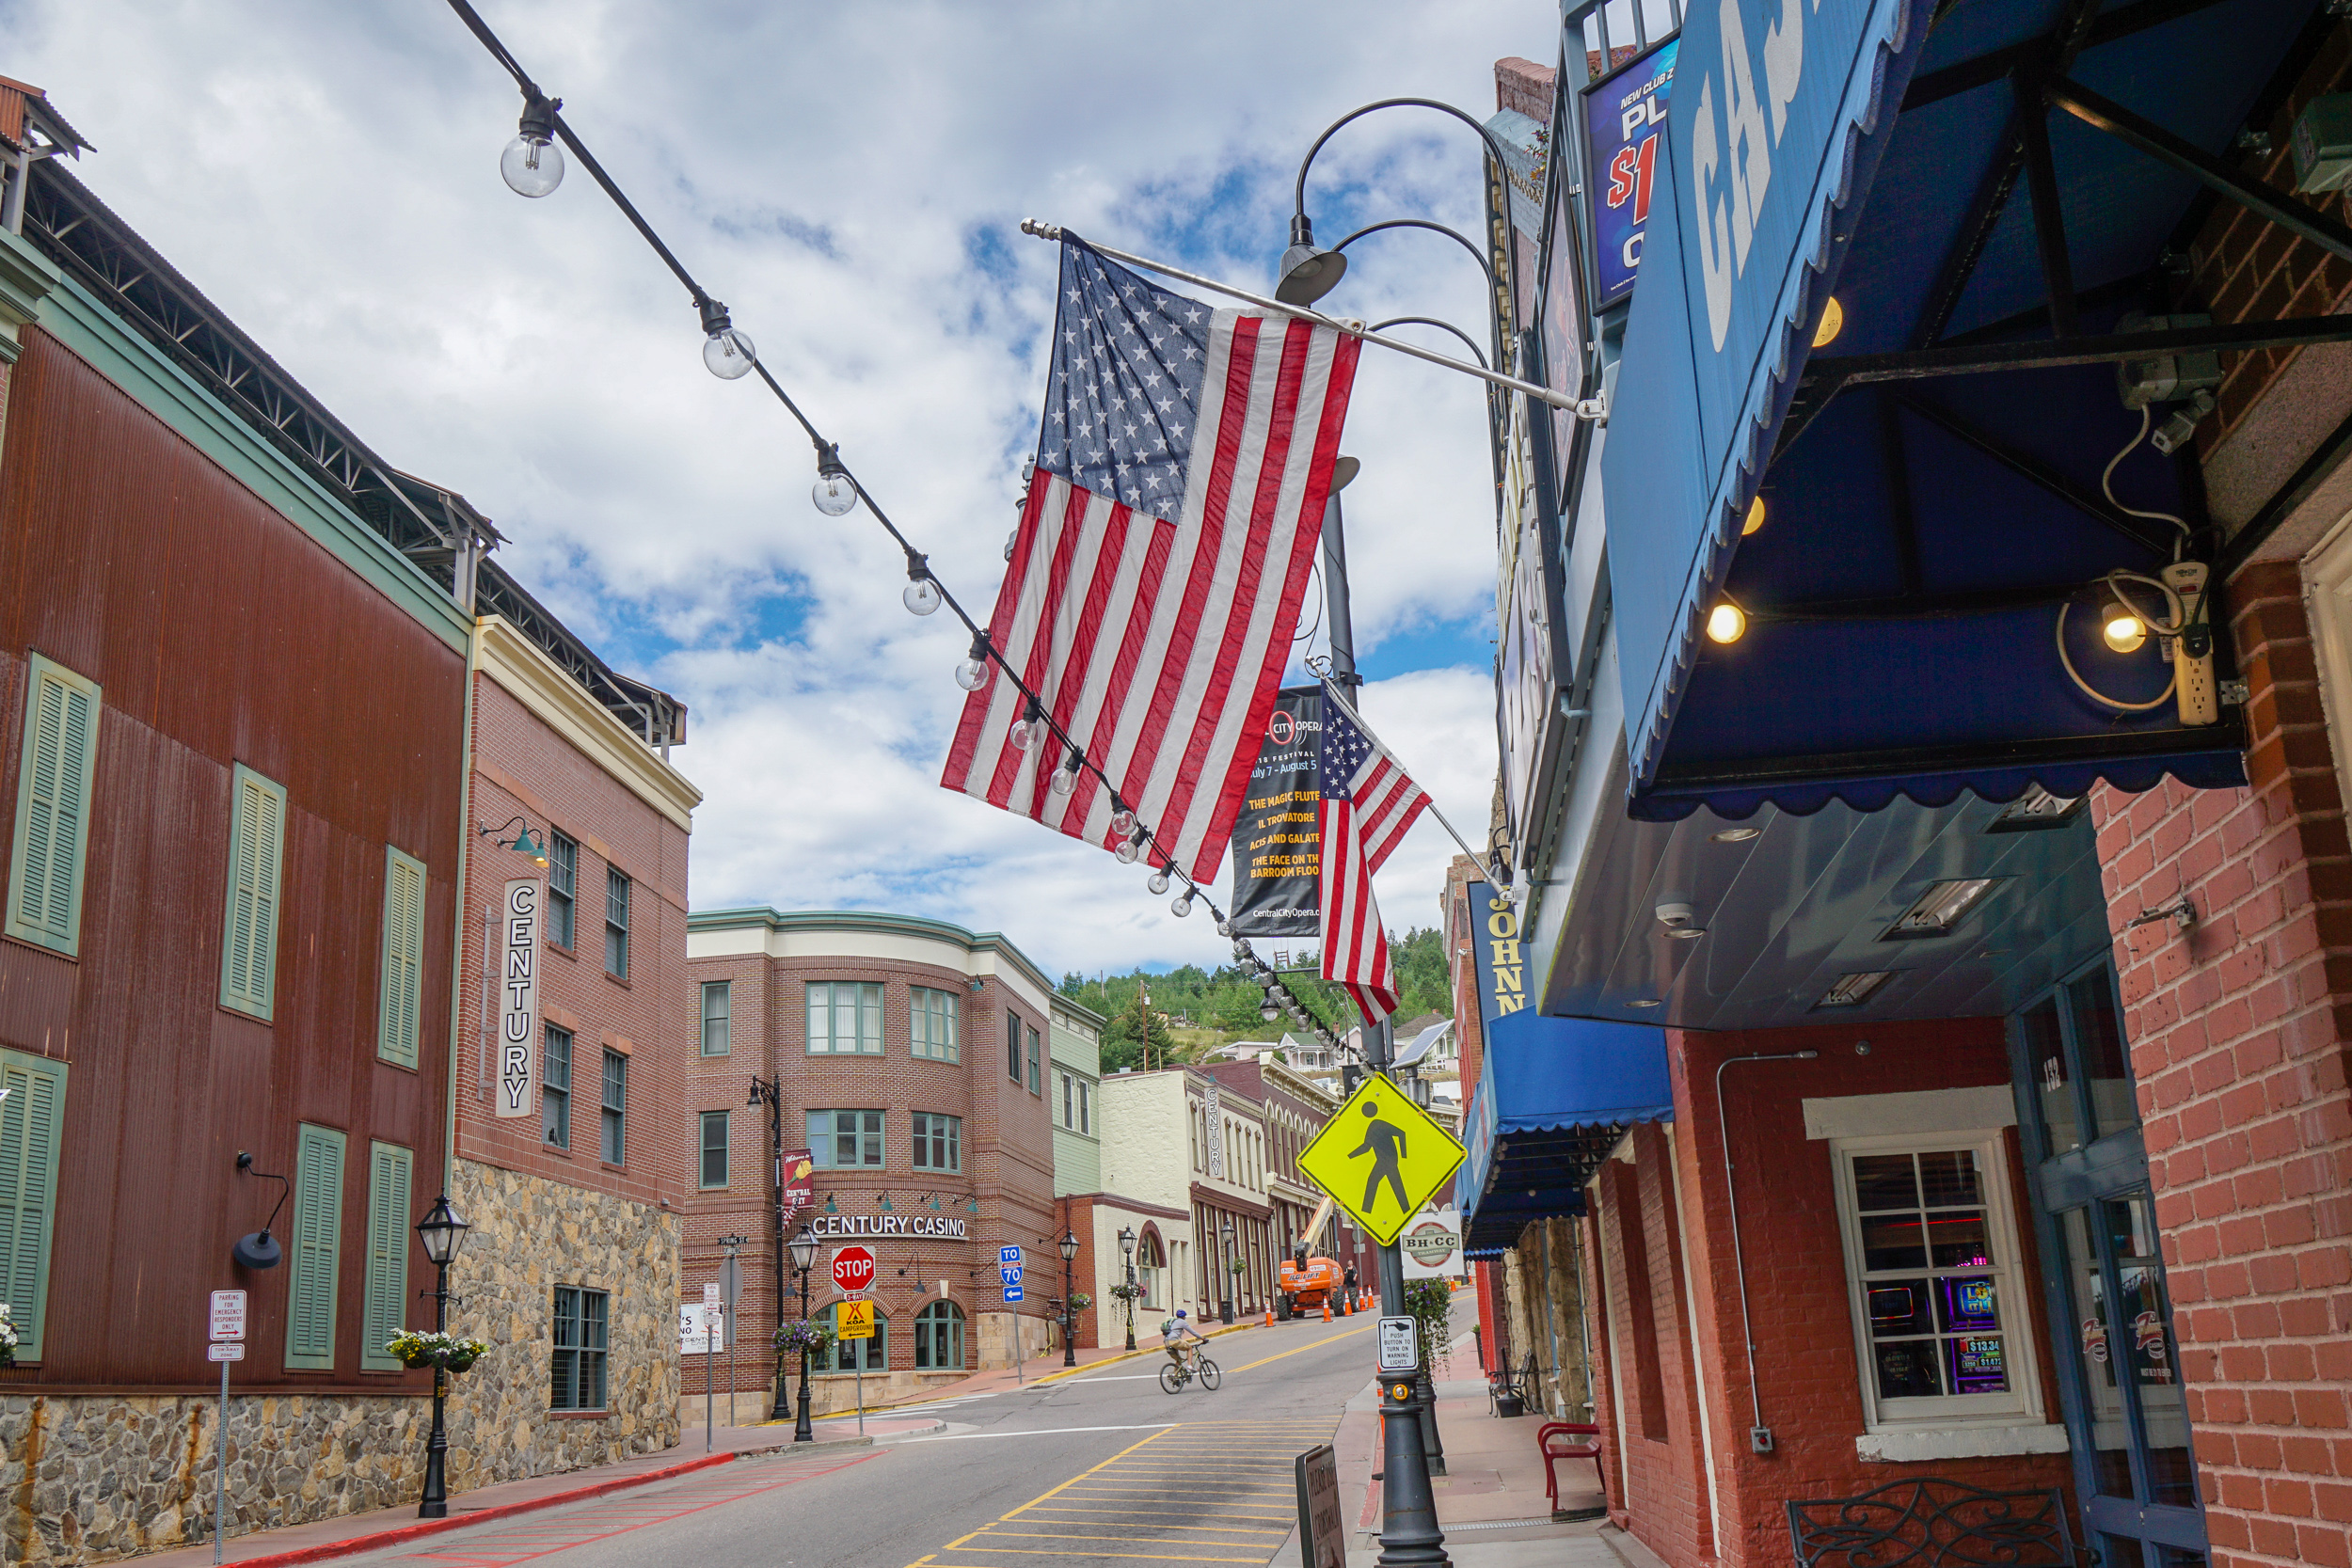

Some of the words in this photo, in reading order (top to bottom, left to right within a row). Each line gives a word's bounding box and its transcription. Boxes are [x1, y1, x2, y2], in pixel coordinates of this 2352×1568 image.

[1621, 91, 1641, 110] NEW
[1643, 75, 1666, 96] CLUB
[1621, 94, 1667, 142] PL
[1273, 722, 1293, 733] CITY
[1272, 751, 1315, 762] FESTIVAL
[1266, 766, 1272, 776] 7
[1280, 760, 1309, 774] August
[1311, 760, 1317, 770] 5
[1248, 798, 1267, 810] THE
[1267, 792, 1293, 807] MAGIC
[1294, 791, 1320, 802] FLUTE
[1258, 819, 1266, 829] IL
[1267, 812, 1315, 827] TROVATORE
[1249, 837, 1266, 851] ACIS
[1267, 834, 1286, 844] AND
[1252, 855, 1268, 867] THE
[1269, 855, 1290, 865] FACE
[1292, 854, 1305, 864] ON
[1251, 867, 1294, 878] BARROOM
[503, 885, 536, 1109] CENTURY
[2043, 1056, 2061, 1092] 132
[1207, 1089, 1221, 1175] CENTURY
[785, 1154, 805, 1164] Welcome
[786, 1188, 811, 1197] CENTRAL
[812, 1215, 909, 1235] CENTURY
[912, 1216, 965, 1236] CASINO
[1003, 1249, 1017, 1259] TO
[835, 1259, 872, 1278] STOP
[1004, 1269, 1020, 1282] 70
[840, 1324, 873, 1333] CAMPGROUND
